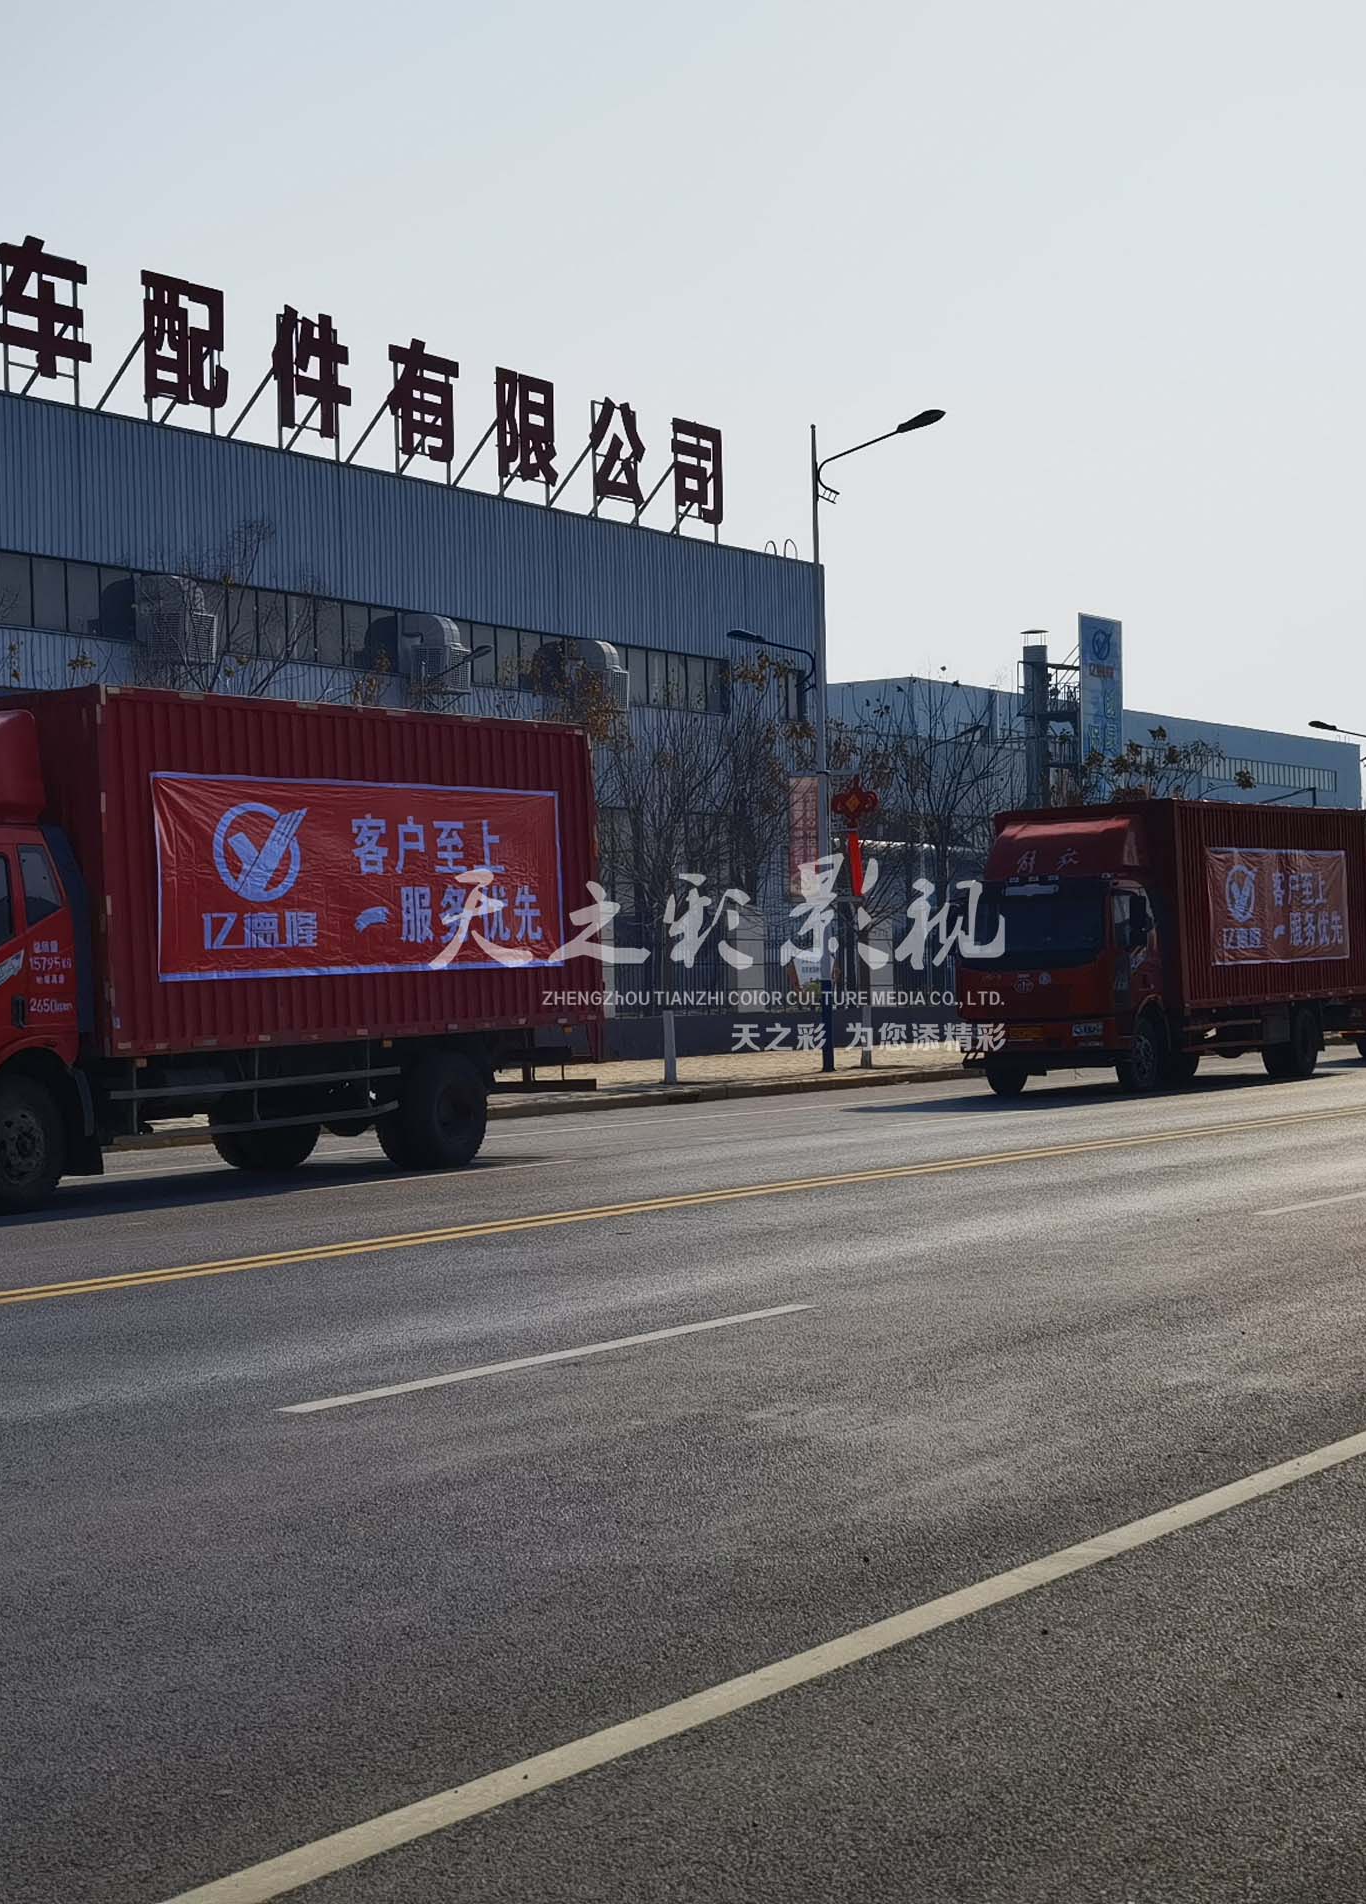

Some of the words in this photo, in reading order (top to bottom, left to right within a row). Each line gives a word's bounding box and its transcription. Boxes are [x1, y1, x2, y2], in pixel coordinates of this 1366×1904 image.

[350, 813, 506, 876] 客户至上
[201, 910, 319, 951] 亿德隆
[400, 884, 544, 945] 服务优先
